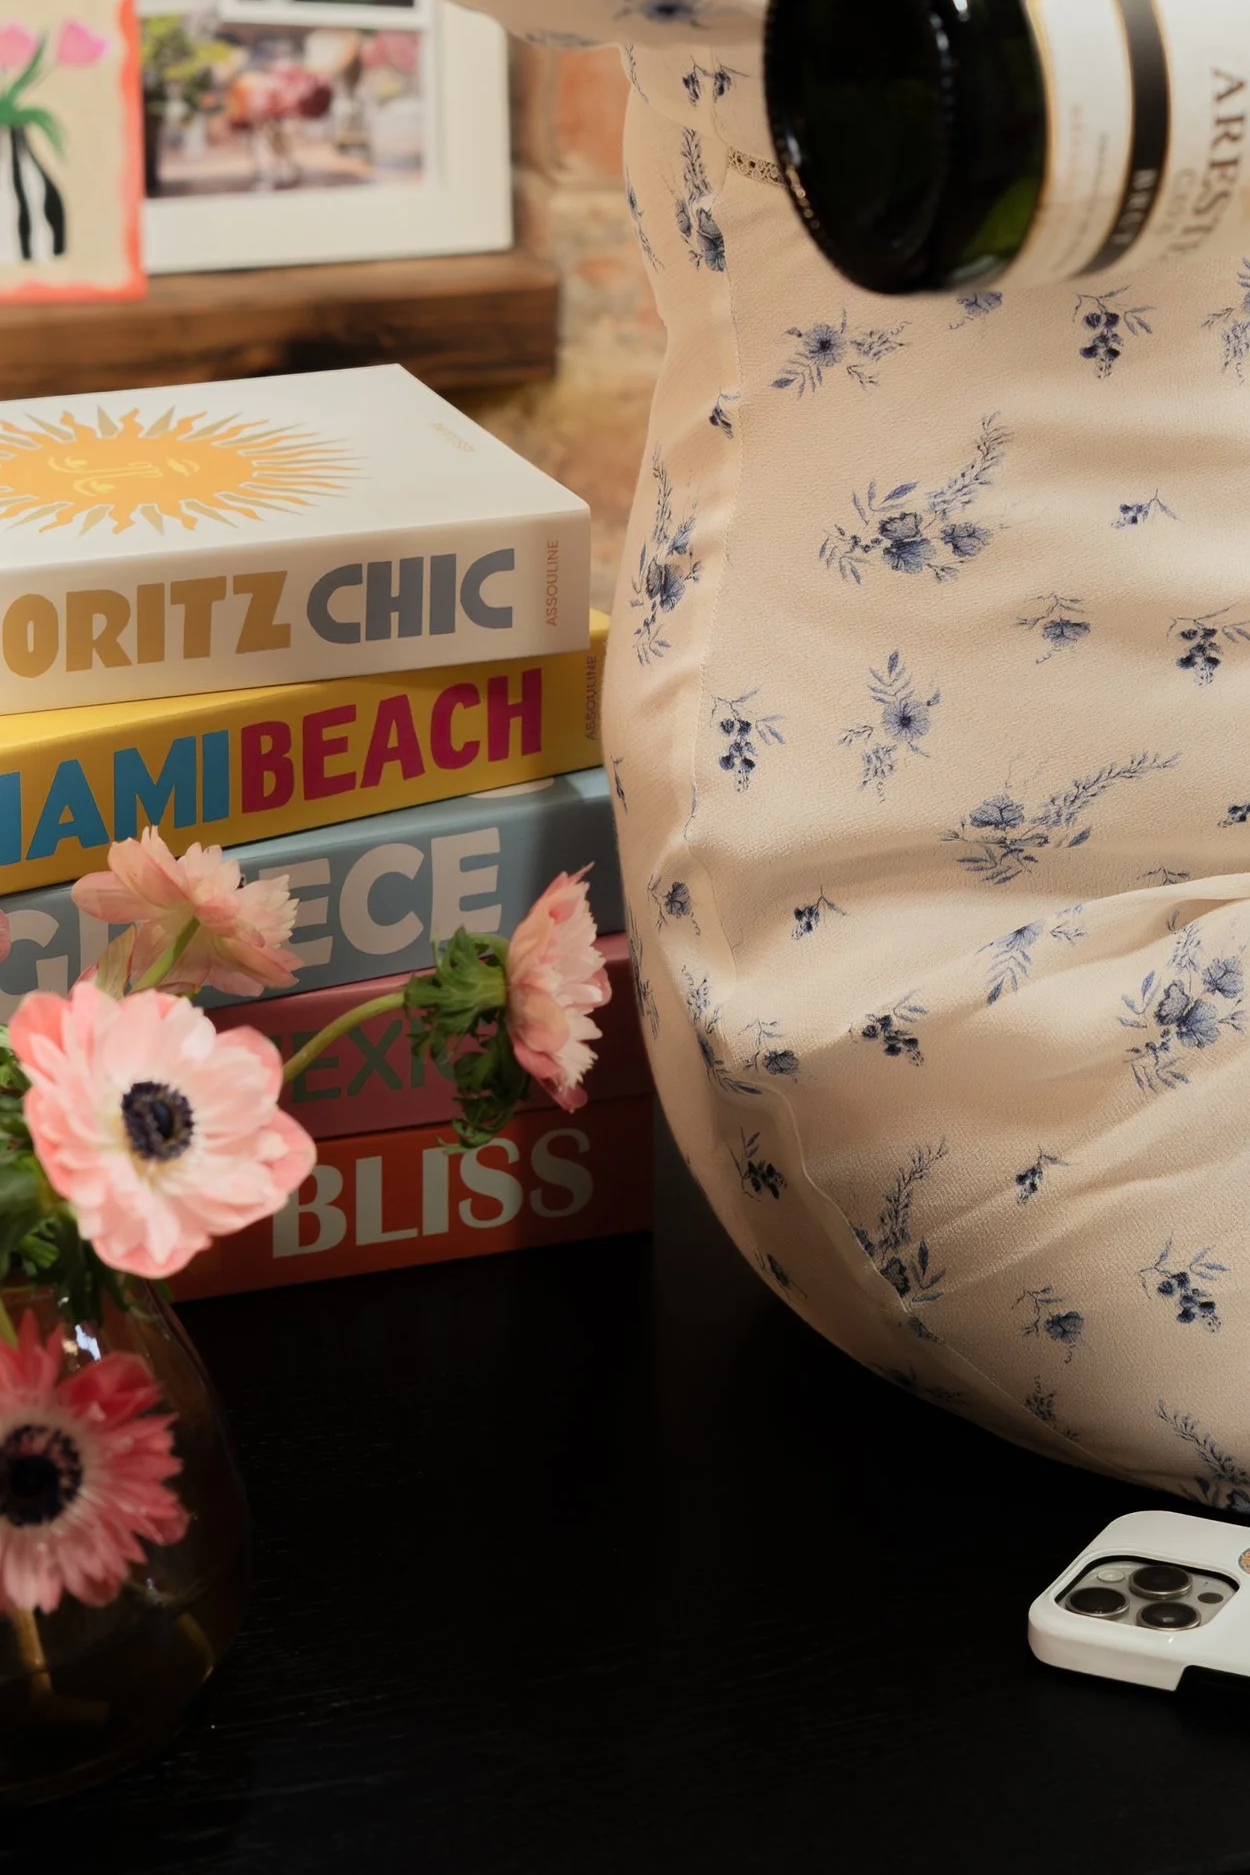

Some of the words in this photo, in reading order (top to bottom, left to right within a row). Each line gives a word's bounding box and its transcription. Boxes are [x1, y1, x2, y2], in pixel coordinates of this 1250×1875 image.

[306, 547, 515, 645] CHIC
[546, 539, 558, 627] ASSOULINE
[241, 667, 542, 814] BEACH
[585, 655, 597, 741] ASSOULINE
[273, 1127, 594, 1258] BLISS
